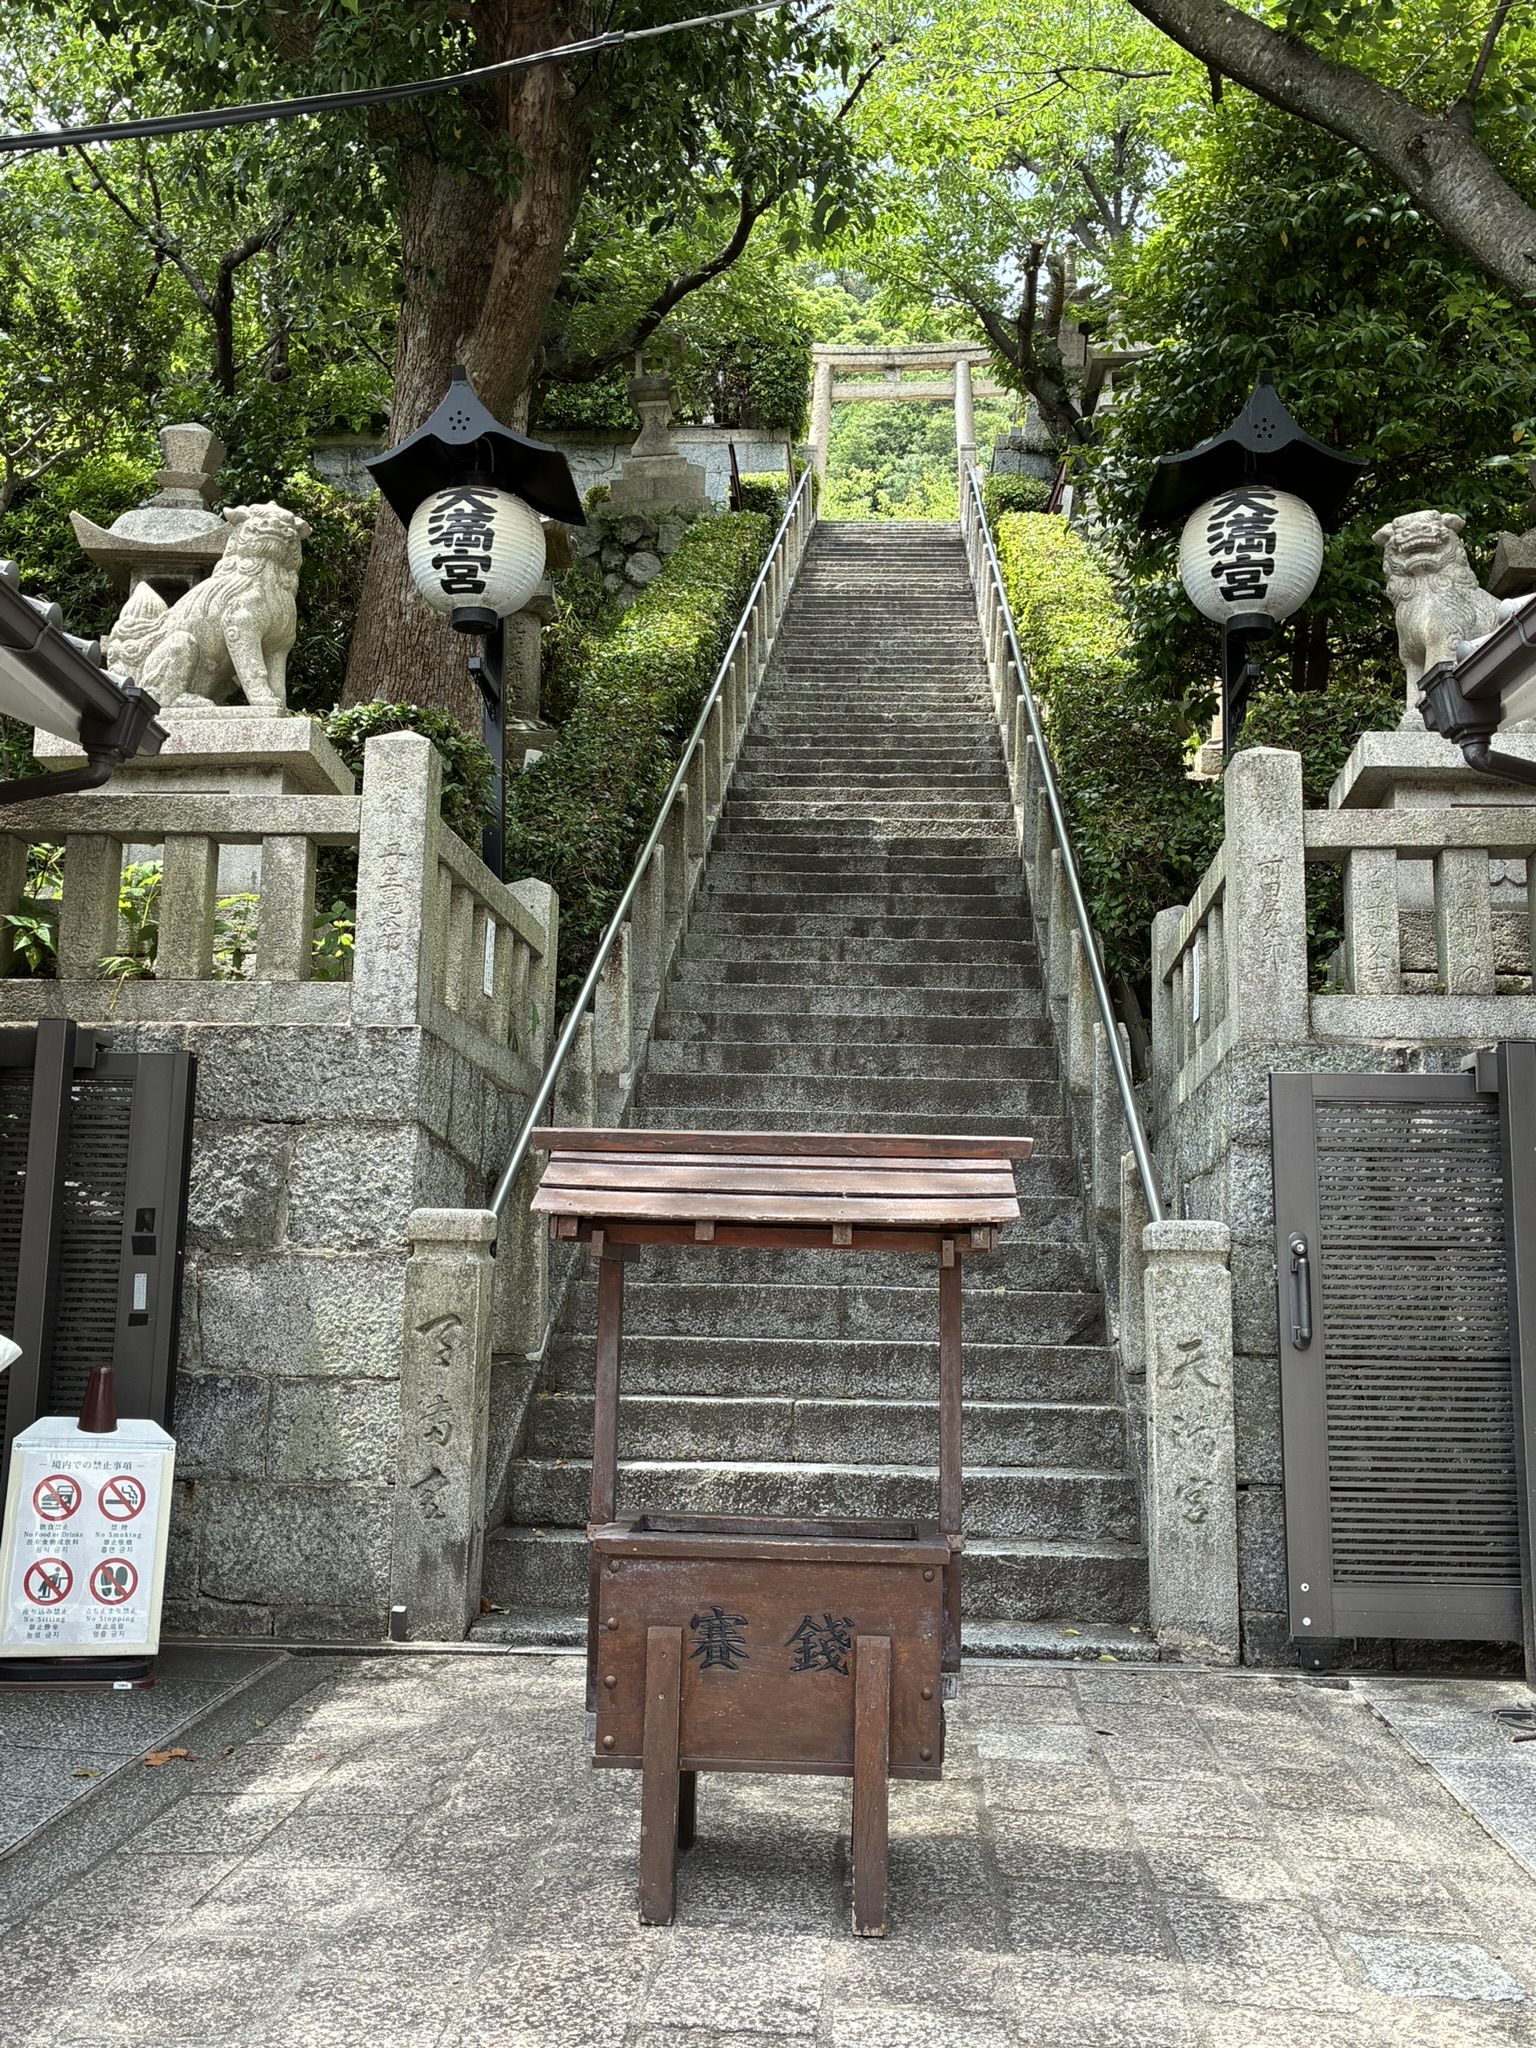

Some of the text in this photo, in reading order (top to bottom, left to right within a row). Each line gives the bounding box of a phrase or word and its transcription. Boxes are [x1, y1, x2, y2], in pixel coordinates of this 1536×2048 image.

[428, 487, 498, 595] 天満宮
[1207, 485, 1279, 602] 天満宮
[51, 1460, 133, 1471] 境内での禁止事項
[108, 1531, 143, 1540] Smoking
[37, 1616, 66, 1624] Sitting
[99, 1615, 136, 1624] Stopping
